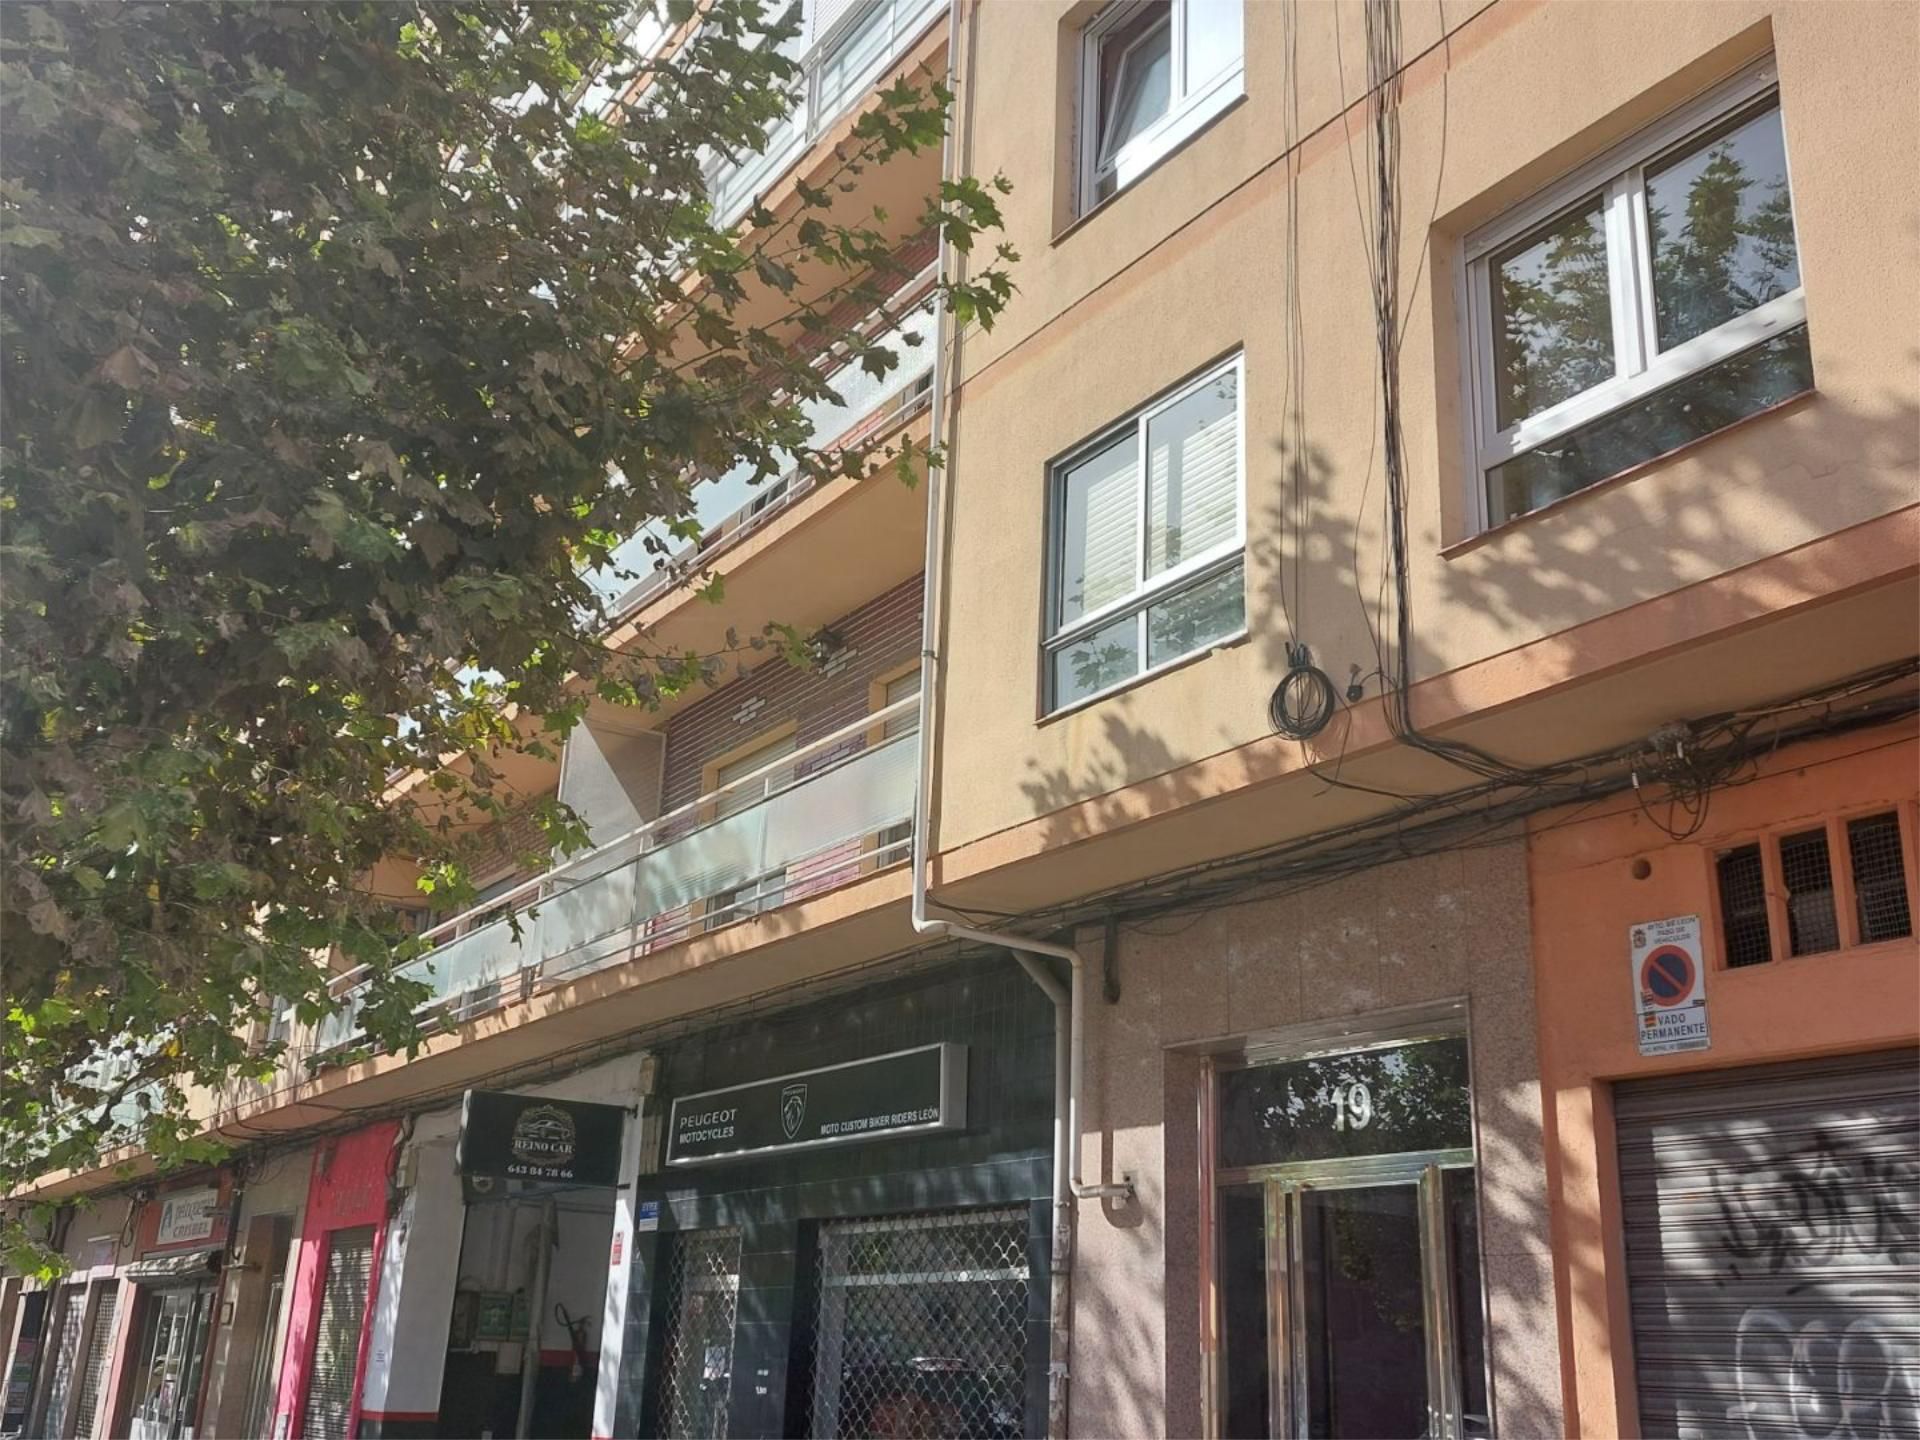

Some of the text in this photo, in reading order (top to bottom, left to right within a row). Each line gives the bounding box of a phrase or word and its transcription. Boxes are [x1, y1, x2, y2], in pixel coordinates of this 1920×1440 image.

[1657, 1012, 1686, 1026] VADO
[1640, 1022, 1706, 1041] PERMANENTE
[1330, 1083, 1371, 1131] 19
[680, 1108, 738, 1130] PEUGEOT
[820, 1105, 939, 1135] MOTO CUSTOM BIKER RIDERS LEÓN
[679, 1125, 735, 1145] MOTOCYCLES
[514, 1140, 573, 1154] REINO CAR
[560, 1169, 574, 1179] 66
